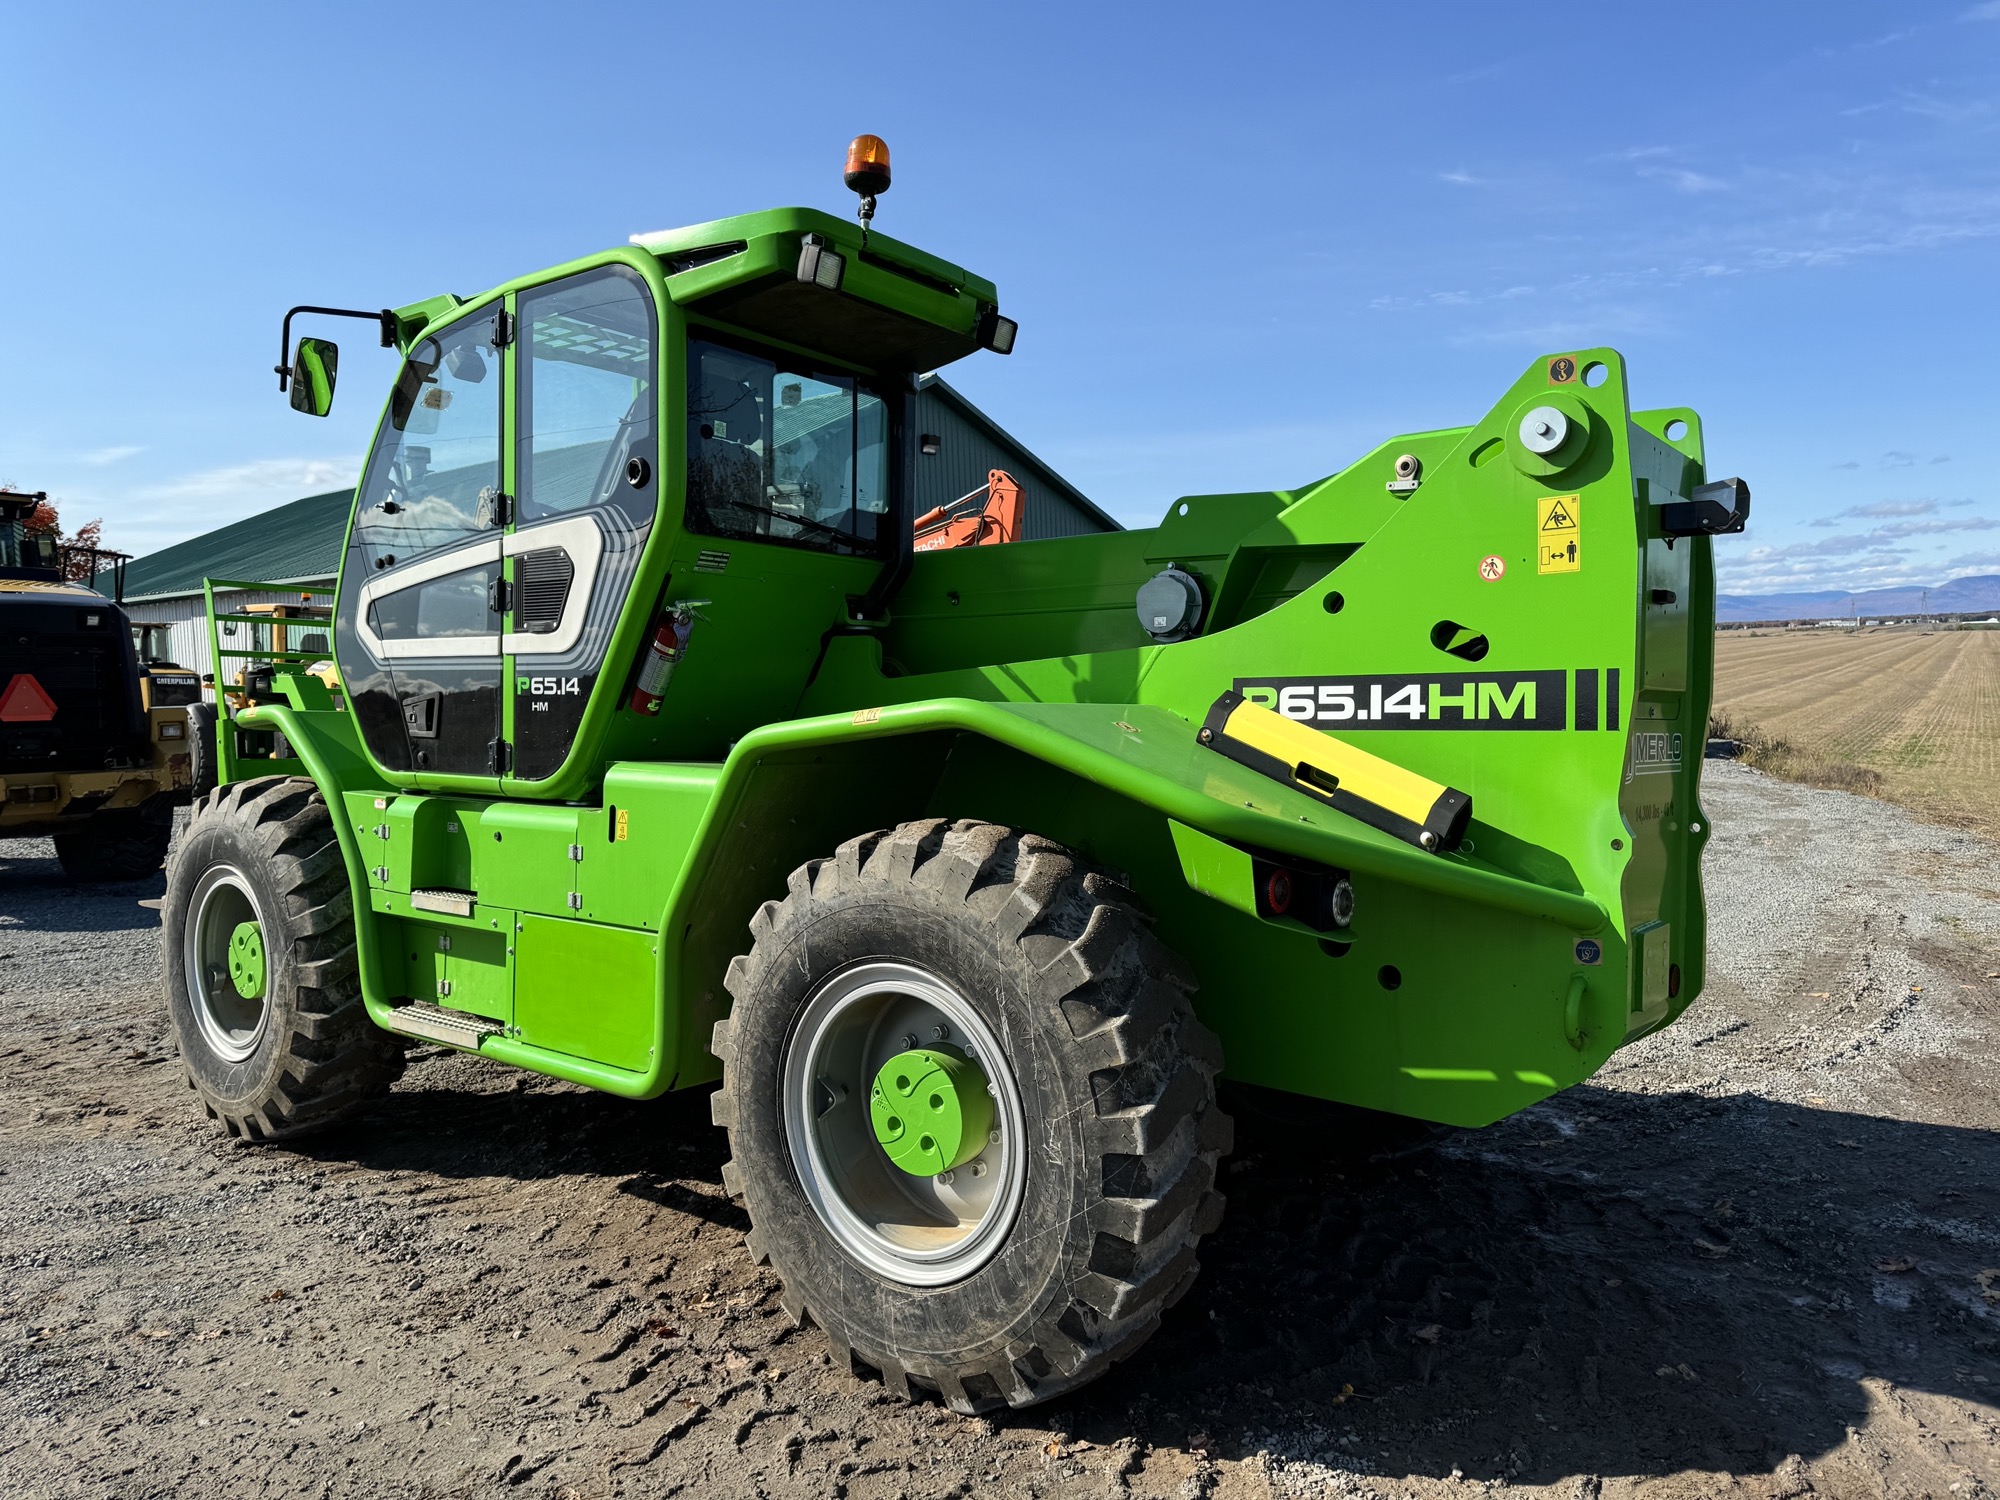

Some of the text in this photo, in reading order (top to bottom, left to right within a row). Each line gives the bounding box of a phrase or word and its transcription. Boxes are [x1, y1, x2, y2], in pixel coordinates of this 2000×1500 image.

[156, 677, 196, 685] CATERPILLAR
[516, 676, 581, 696] P65.14
[531, 701, 549, 712] HM
[1635, 732, 1682, 762] MERLO
